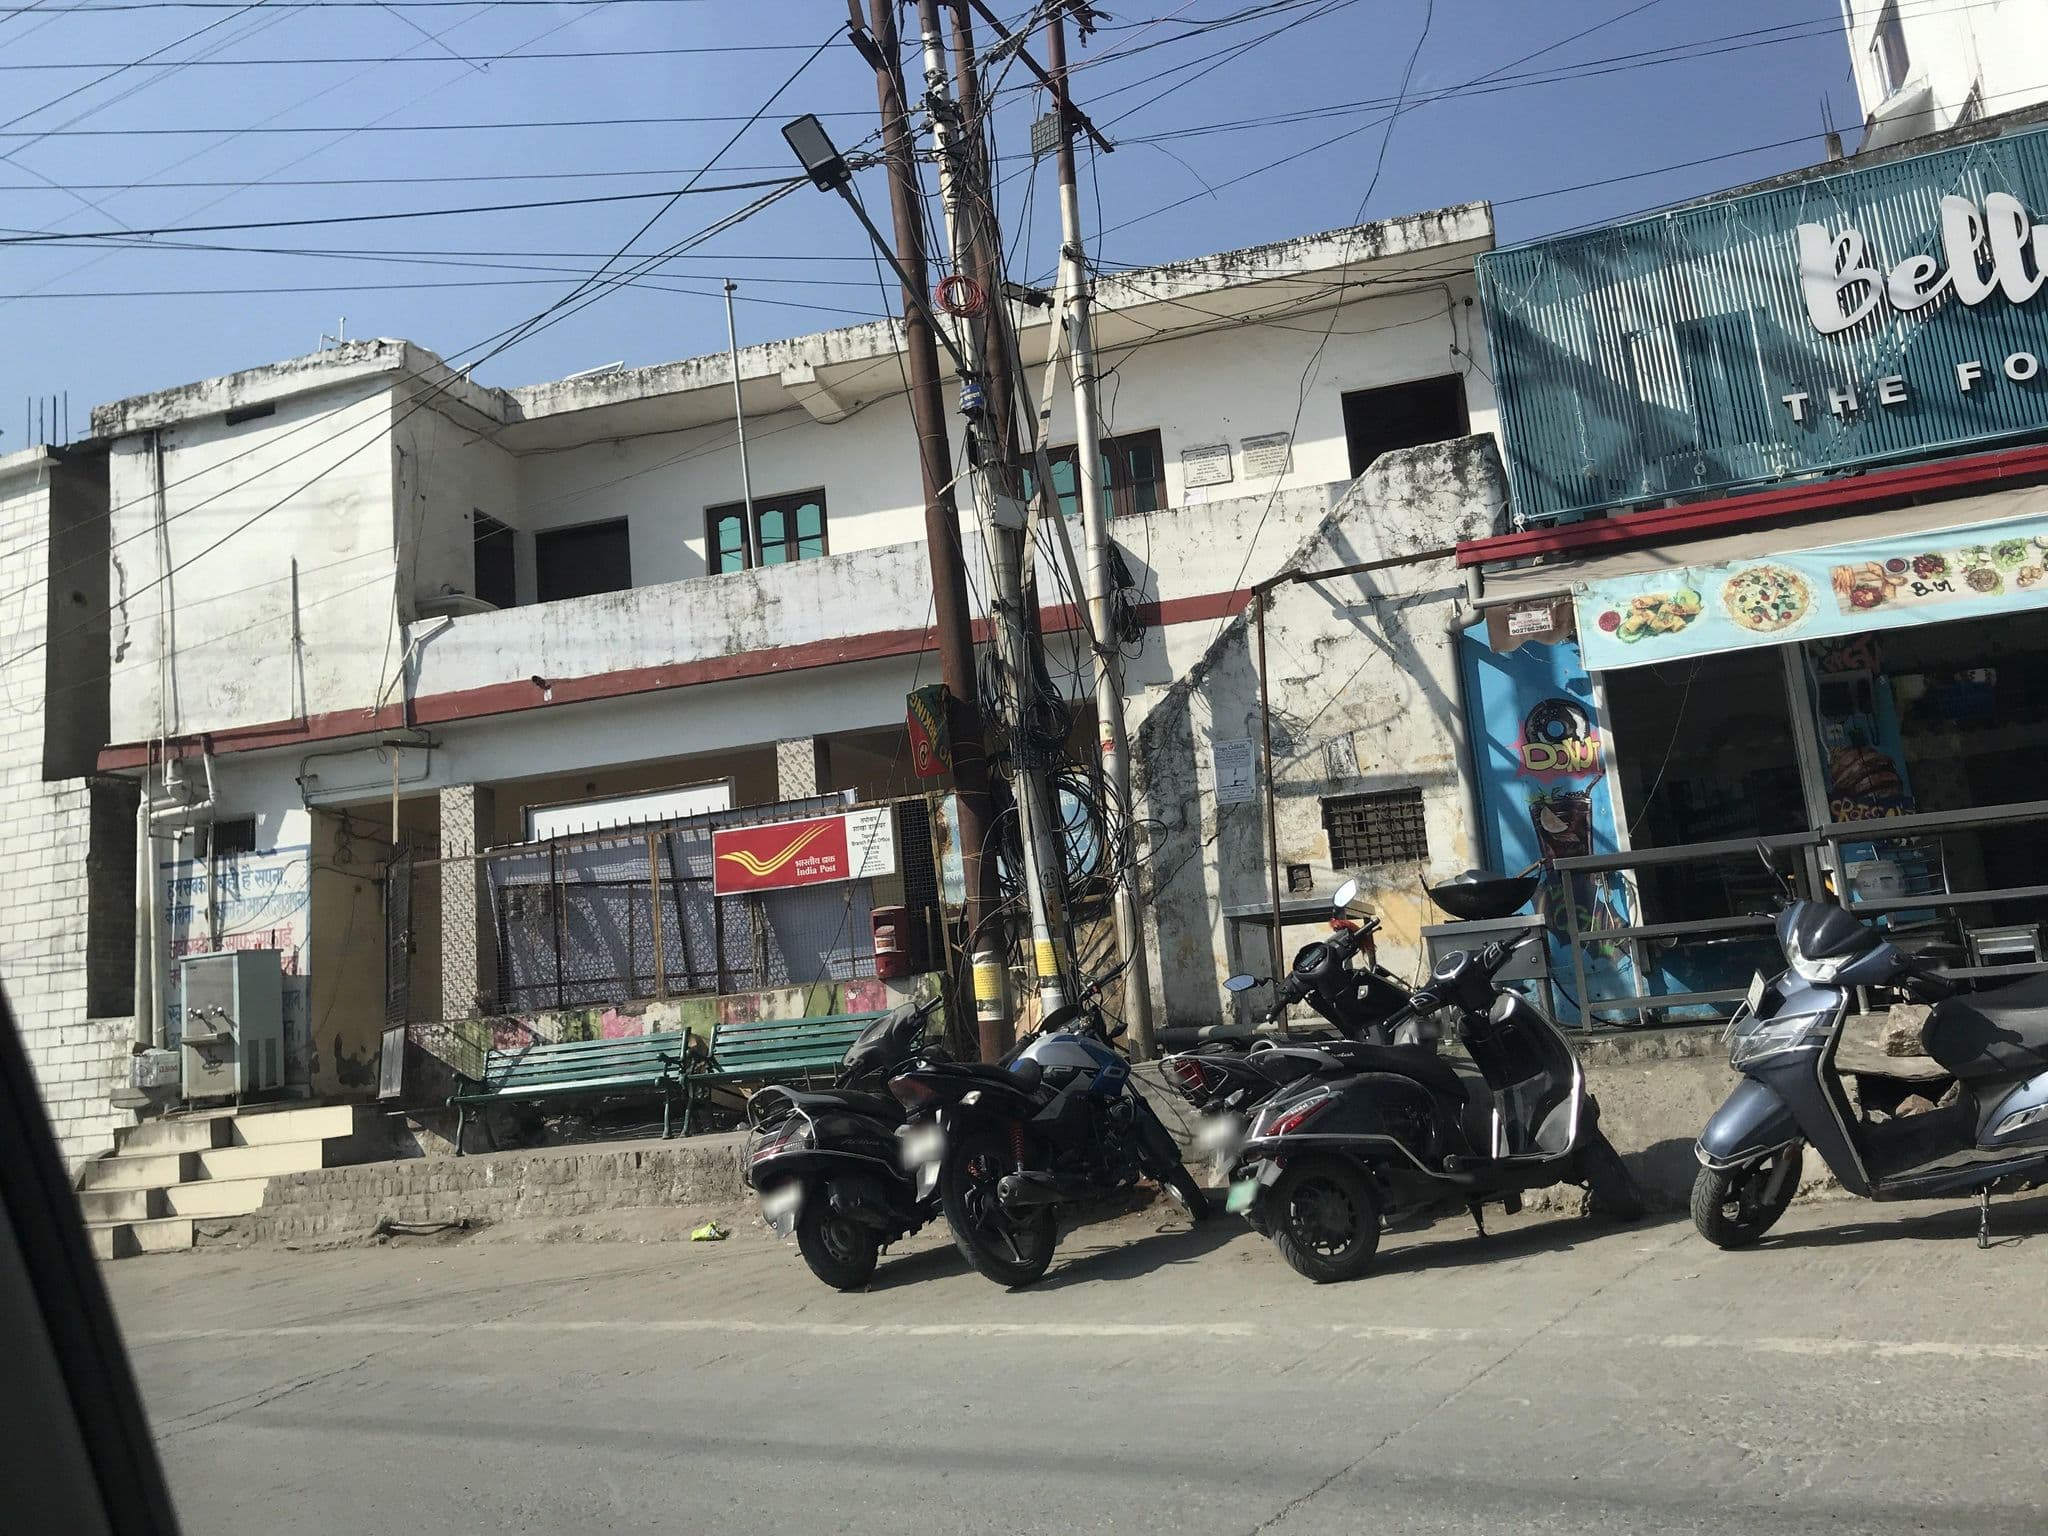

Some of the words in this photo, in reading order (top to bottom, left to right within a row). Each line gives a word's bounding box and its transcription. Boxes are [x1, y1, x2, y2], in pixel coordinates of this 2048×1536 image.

[1782, 374, 1908, 422] THE
[1520, 736, 1601, 773] DONUT
[795, 855, 820, 868] भारतीय
[796, 866, 817, 877] India
[819, 864, 836, 874] Post
